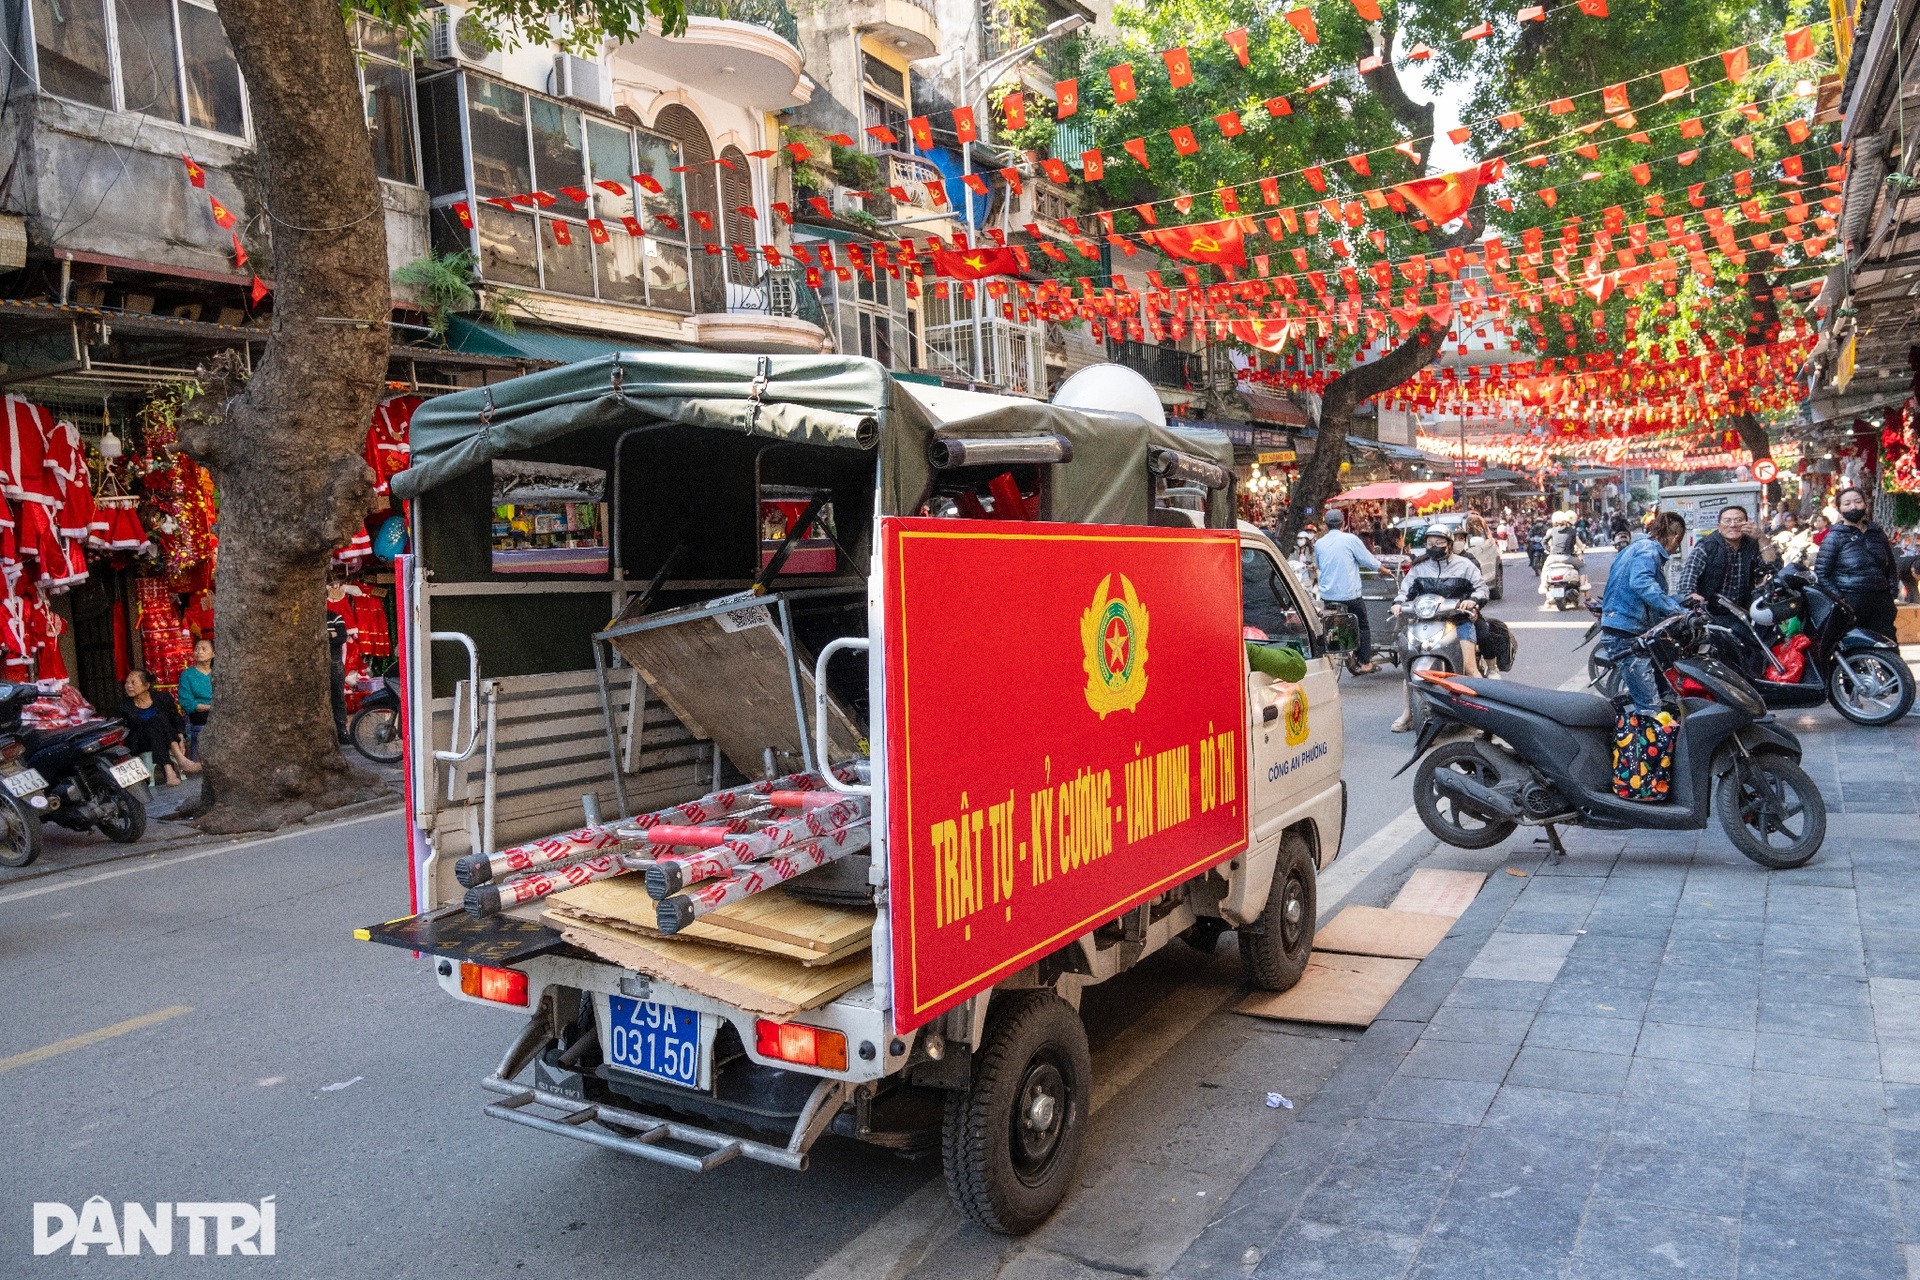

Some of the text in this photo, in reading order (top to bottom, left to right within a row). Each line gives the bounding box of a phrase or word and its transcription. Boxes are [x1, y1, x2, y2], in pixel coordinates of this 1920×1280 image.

[1268, 741, 1328, 782] CÔNG AN PHƯỜNG
[931, 790, 983, 941] TRẬT
[989, 788, 1014, 922] TỰ
[1031, 754, 1053, 887] KỶ
[1058, 765, 1112, 875] CƯƠNG
[1124, 740, 1154, 845] VĂN
[1156, 744, 1190, 832] MINH
[1200, 720, 1216, 813] ĐÔ
[1218, 730, 1236, 817] THỊ
[630, 1001, 677, 1033] 29A
[613, 1025, 695, 1080] 031.50
